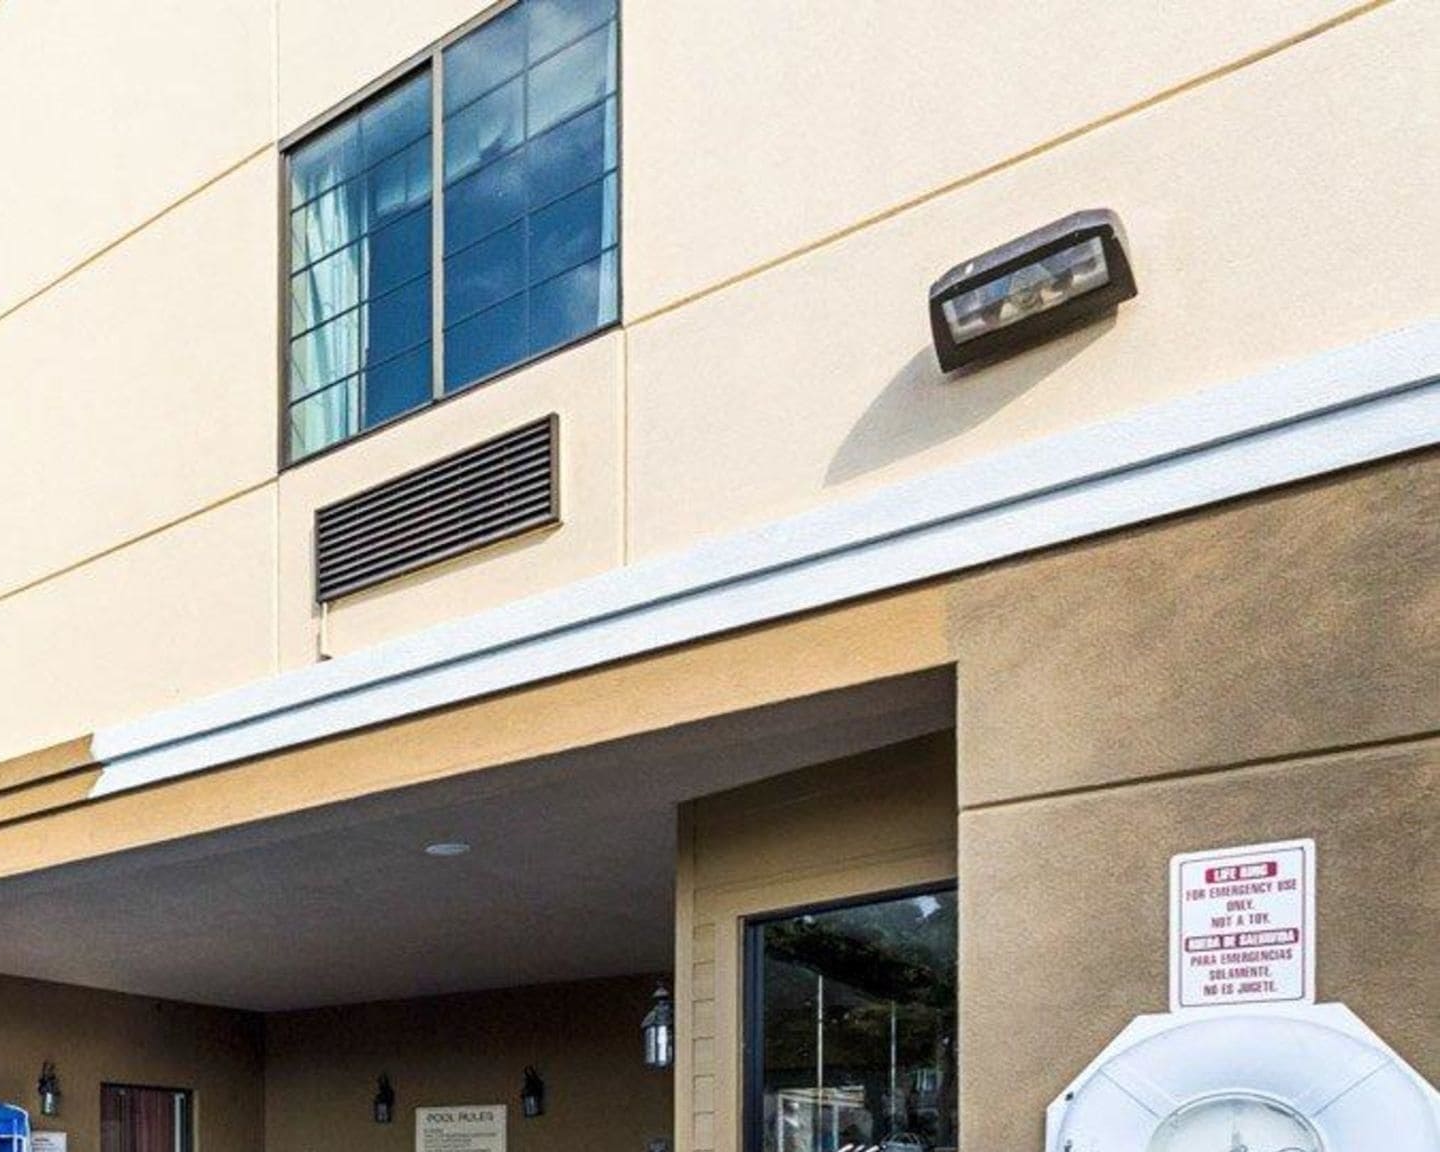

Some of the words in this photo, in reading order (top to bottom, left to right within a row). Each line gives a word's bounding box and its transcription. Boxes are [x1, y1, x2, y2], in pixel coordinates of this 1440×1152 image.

[1186, 889, 1206, 901] FOR
[1209, 882, 1272, 898] EMERGENCY
[1278, 879, 1296, 892] USE
[1211, 916, 1232, 928] NOT
[1237, 914, 1245, 926] A
[1190, 954, 1216, 966] PARA
[1220, 948, 1293, 965] EMERGENCIAS
[1203, 985, 1217, 996] NO
[1222, 983, 1234, 995] ES
